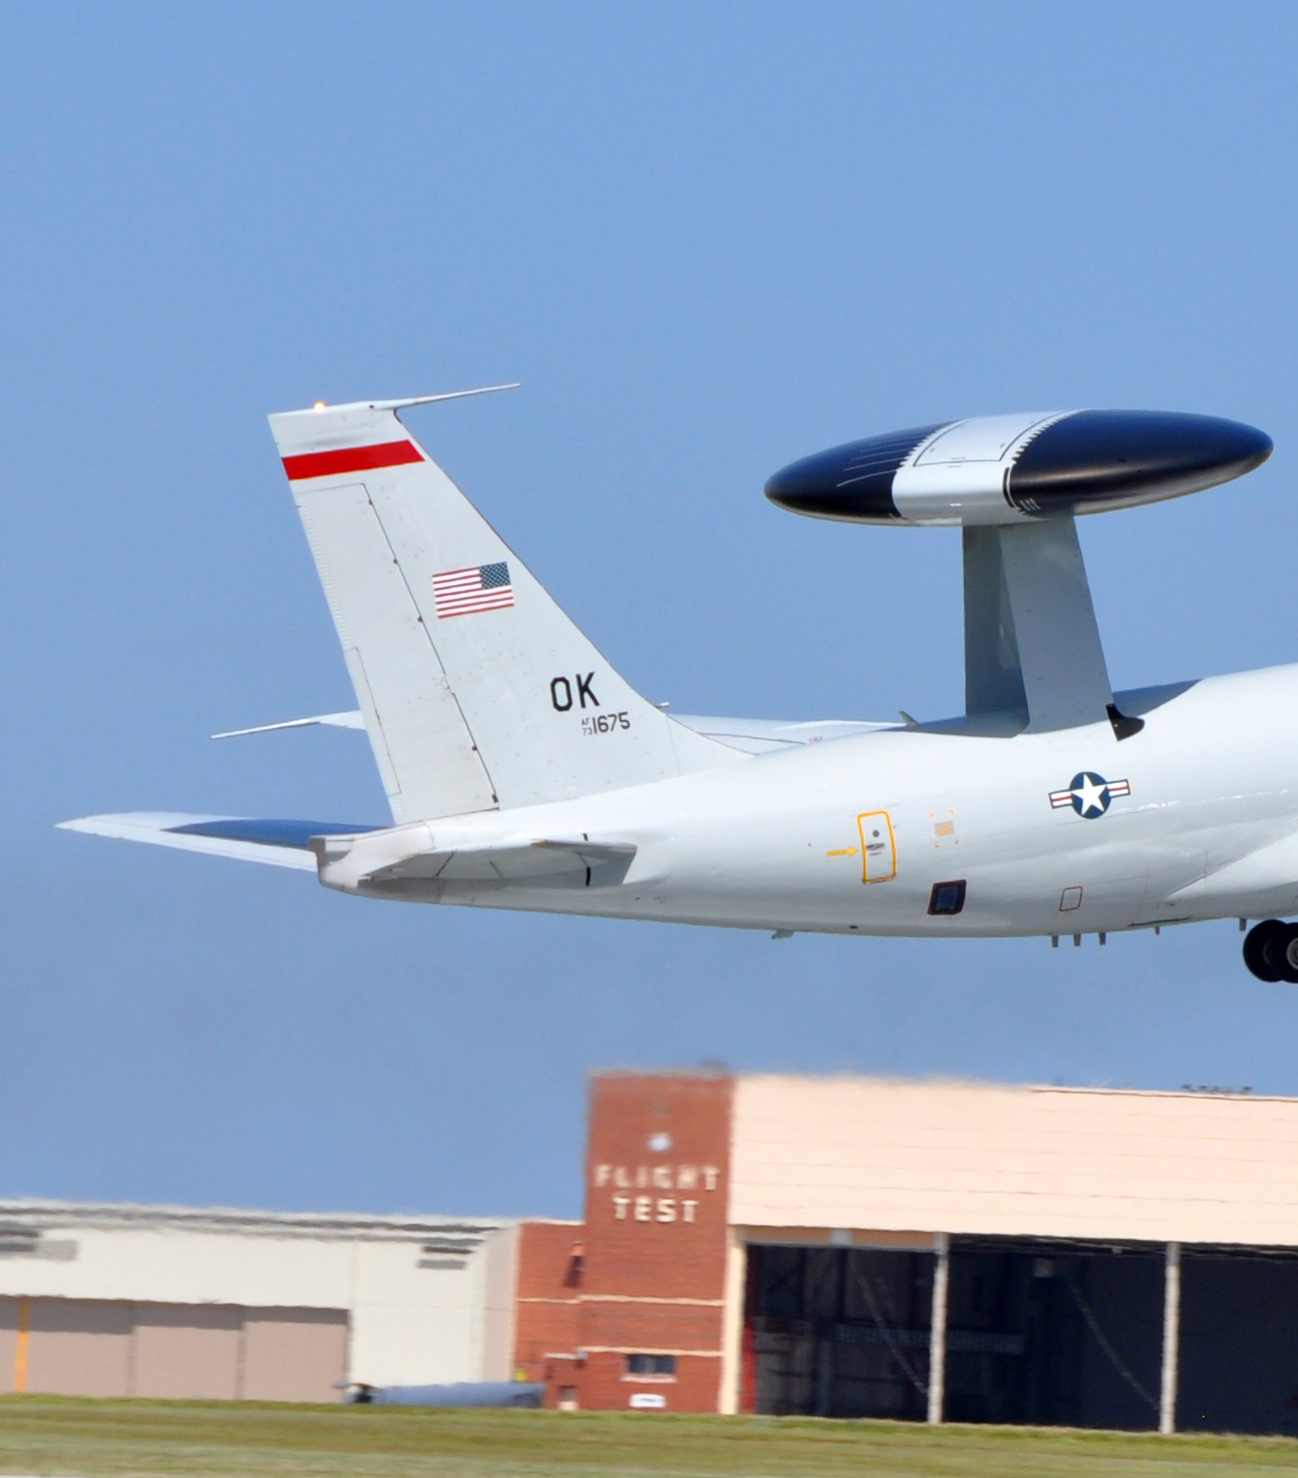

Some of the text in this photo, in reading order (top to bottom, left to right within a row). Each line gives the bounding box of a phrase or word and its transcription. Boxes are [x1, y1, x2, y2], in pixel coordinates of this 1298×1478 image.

[550, 671, 600, 712] OK
[581, 717, 590, 726] AF
[582, 727, 593, 736] 73
[592, 711, 631, 734] 1675
[594, 1163, 720, 1191] FLIGHT
[612, 1196, 700, 1223] TEST
